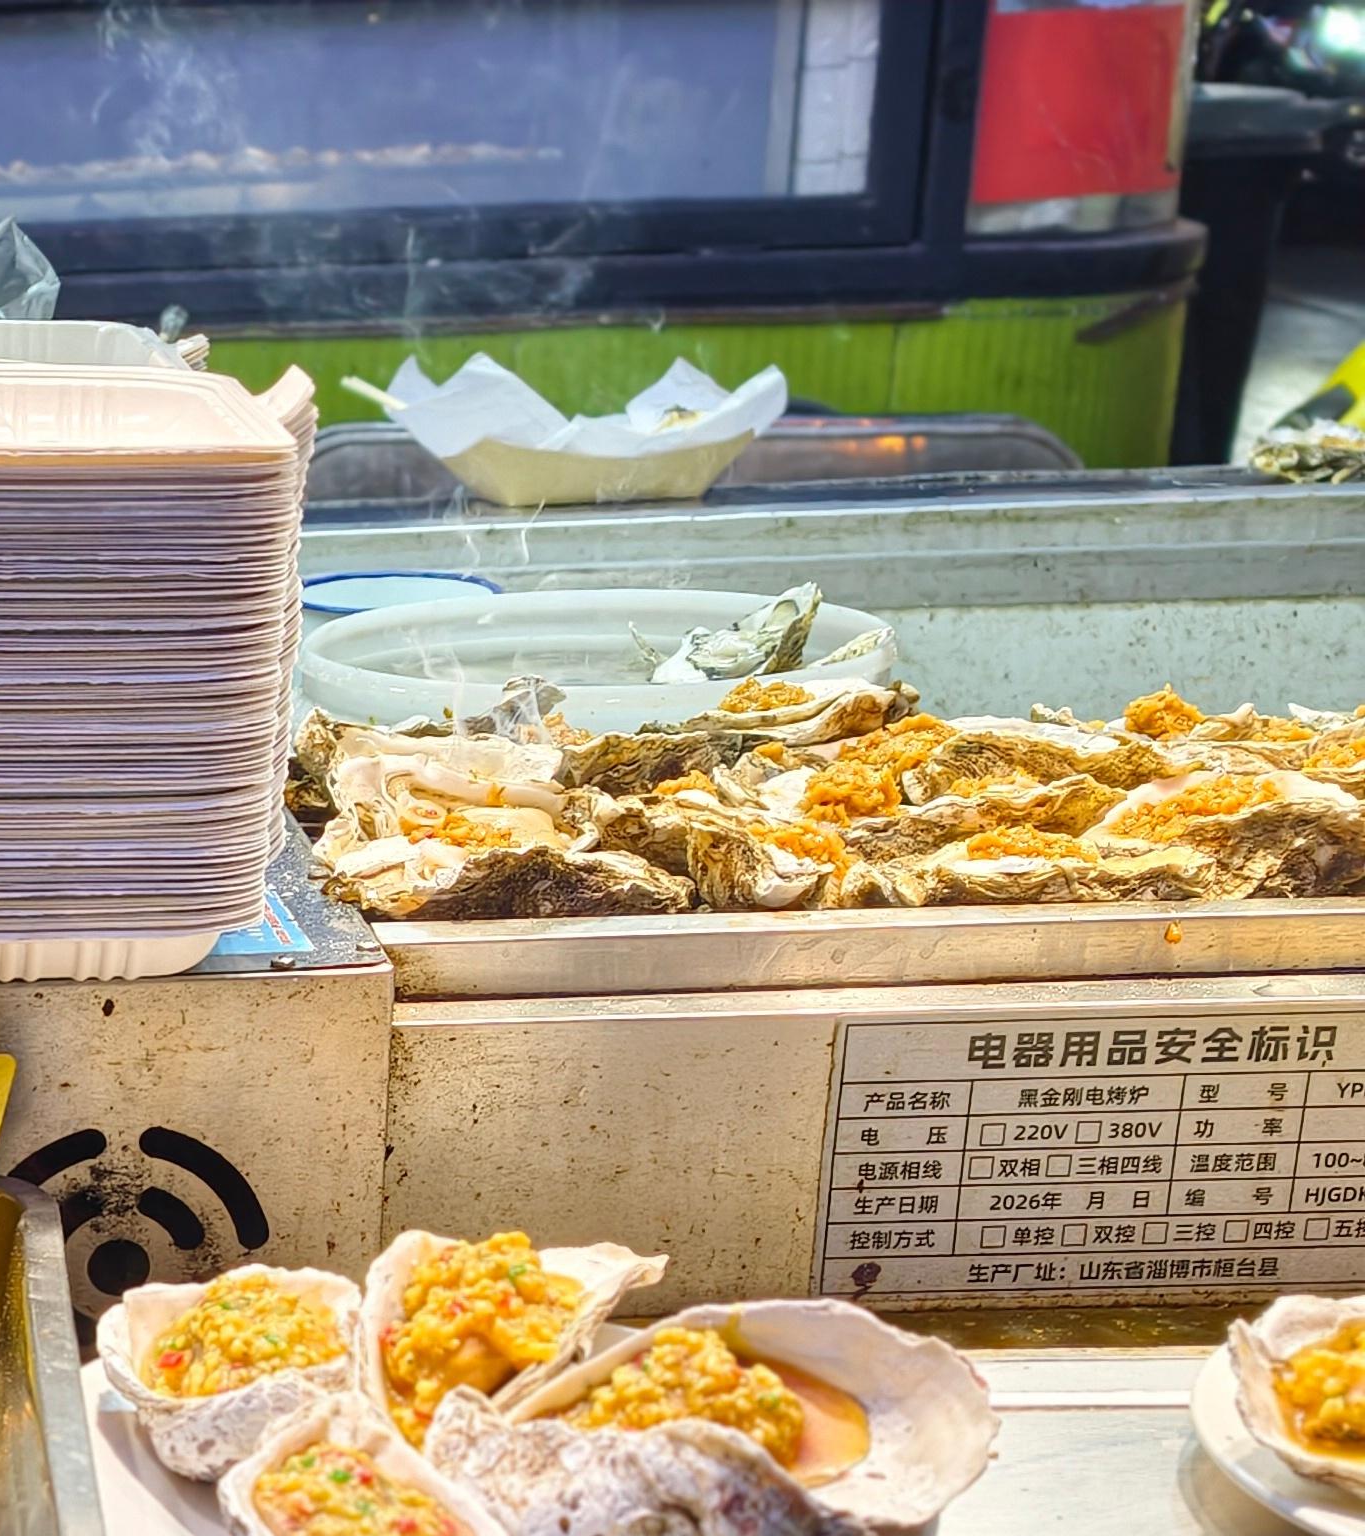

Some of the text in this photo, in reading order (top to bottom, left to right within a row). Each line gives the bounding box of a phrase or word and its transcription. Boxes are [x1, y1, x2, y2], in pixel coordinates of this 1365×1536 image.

[968, 1025, 1338, 1070] 电器用品安全标识
[1018, 1085, 1150, 1108] 黑金刚电烤炉
[1337, 1082, 1365, 1099] YP
[863, 1091, 952, 1112] 产品名称
[1013, 1121, 1163, 1141] 220V 380V
[858, 1160, 943, 1181] 电源相线
[998, 1155, 1163, 1178] 双相 三相四线
[1189, 1152, 1277, 1173] 温度范围
[1312, 1151, 1365, 1169] 100~
[853, 1195, 939, 1215] 生产日期
[989, 1191, 1151, 1211] 2026年 月 日
[850, 1229, 936, 1250] 控制方式
[1012, 1227, 1055, 1246] 单控
[1092, 1224, 1136, 1244] 双控
[1173, 1222, 1217, 1243] 三控
[1253, 1220, 1296, 1241] 四控
